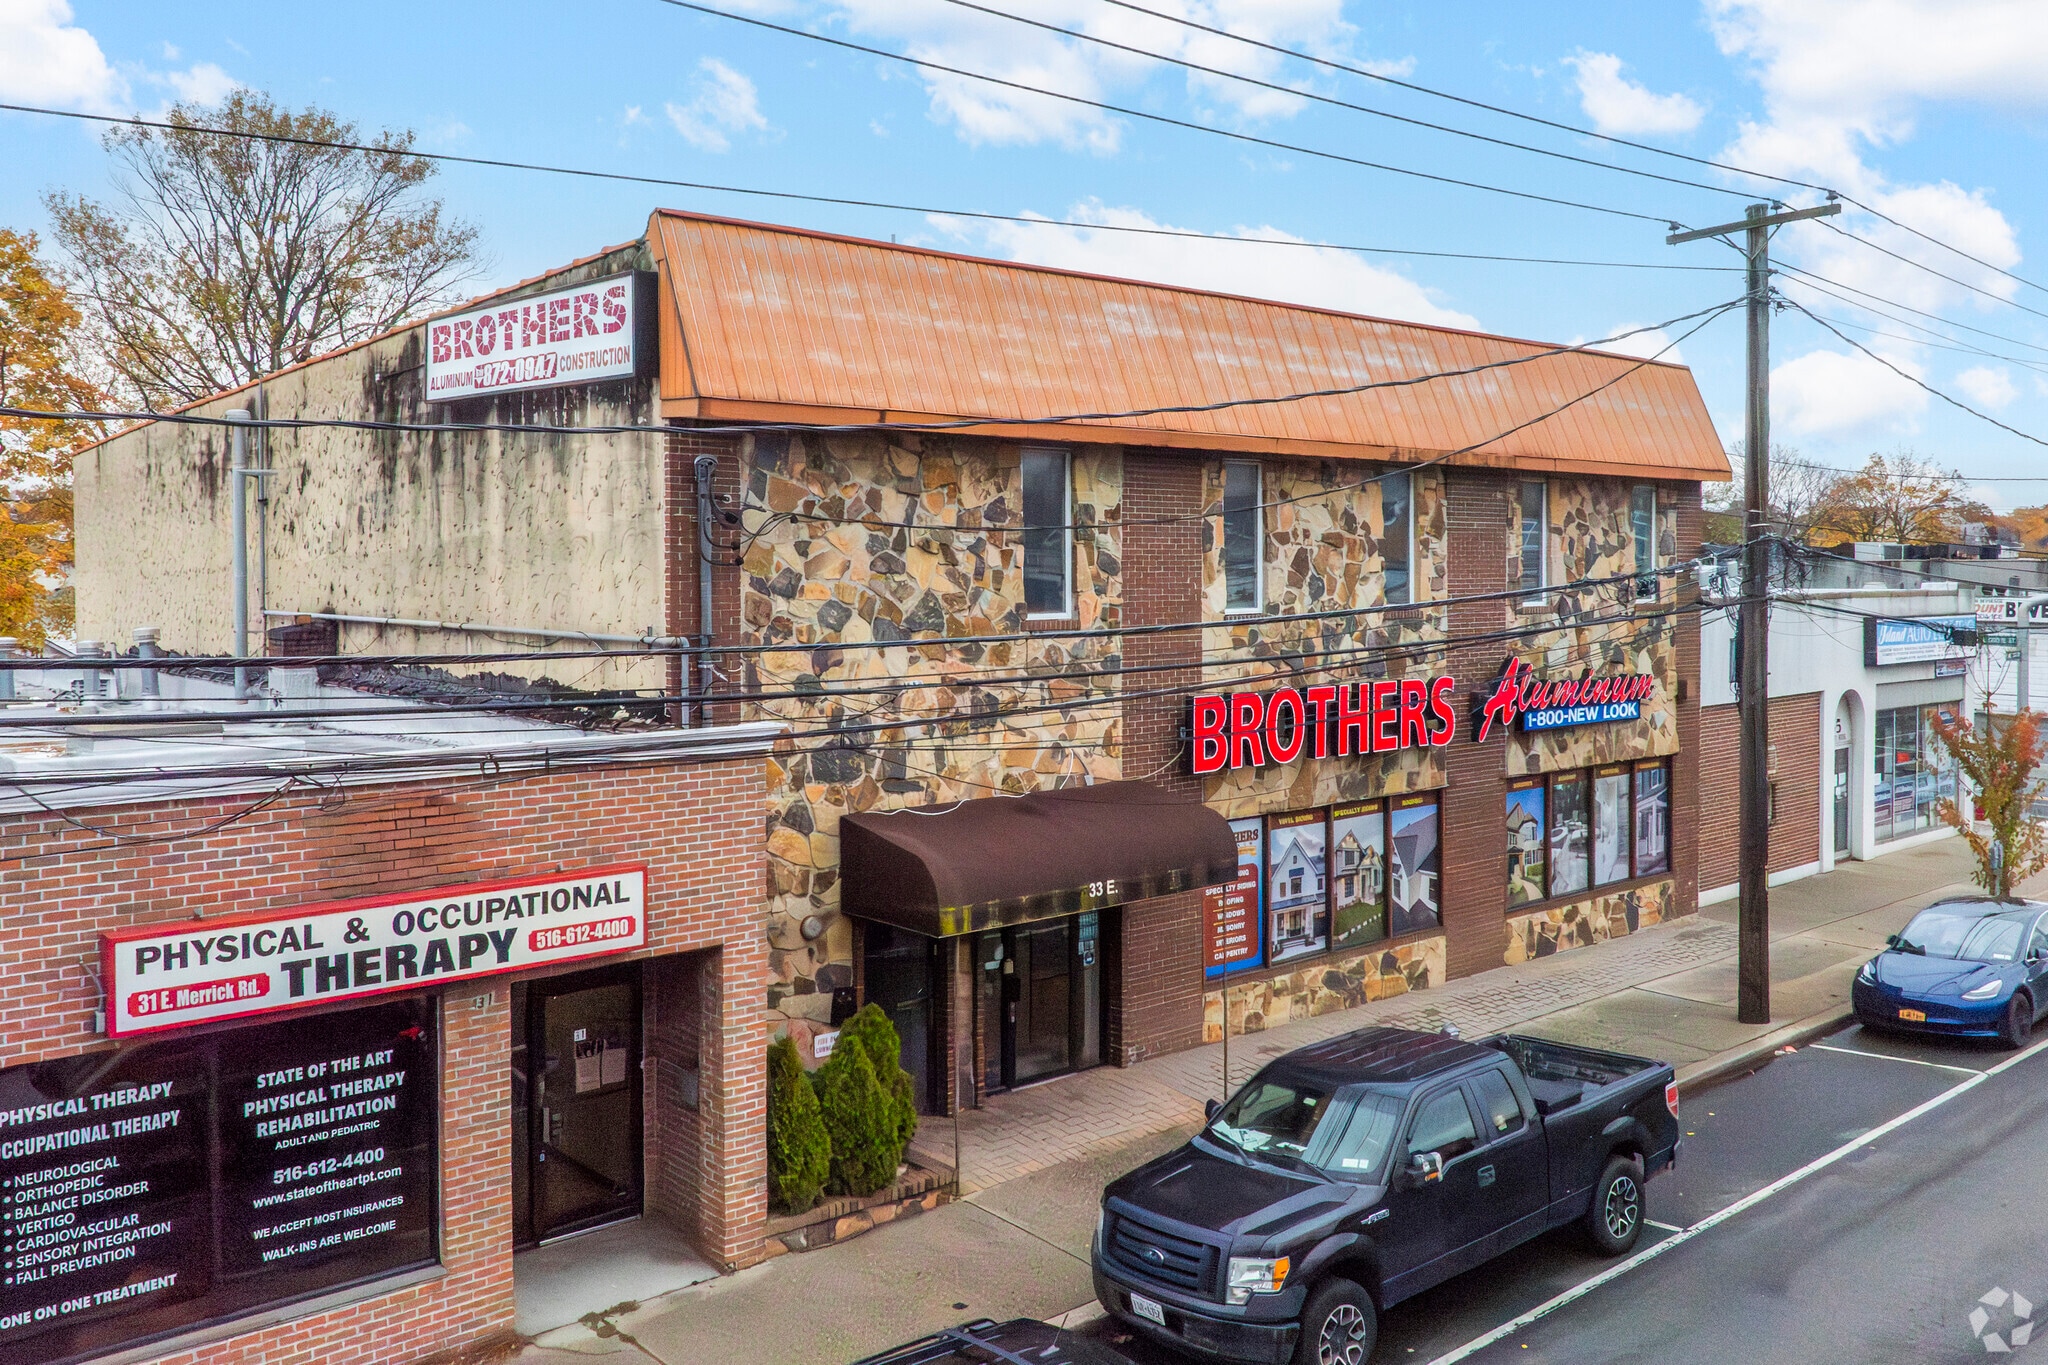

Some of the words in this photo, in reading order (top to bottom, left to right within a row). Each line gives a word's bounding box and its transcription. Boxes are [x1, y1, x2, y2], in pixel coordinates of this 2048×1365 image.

[433, 285, 627, 364] BROTHERS
[430, 371, 473, 391] ALUMINUM
[560, 345, 630, 371] CONSTRUCTION
[1478, 655, 1655, 743] Aluminum
[1527, 706, 1599, 728] 1-800-NEW
[1603, 702, 1638, 719] LOOK
[1193, 676, 1456, 774] BROTHERS
[1089, 881, 1103, 898] 33
[1106, 879, 1118, 895] E.
[136, 923, 324, 975] PHYSICAL
[343, 917, 370, 945] &
[392, 880, 630, 936] OCCUPATIONAL
[281, 927, 518, 998] THERAPY
[536, 918, 629, 949] 516-612-4400
[138, 993, 157, 1014] 31
[160, 990, 174, 1010] E.
[176, 982, 234, 1008] Merrick
[238, 978, 260, 998] Rd.
[256, 1067, 303, 1089] STATE
[307, 1062, 327, 1078] OF
[331, 1056, 360, 1074] THE
[363, 1050, 394, 1069] ART
[0, 1097, 87, 1128] PHYSICAL
[91, 1081, 173, 1111] THERAPY
[243, 1087, 327, 1118] PHYSICAL
[331, 1071, 406, 1099] THERAPY
[0, 1124, 110, 1160] CCUPATIONAL
[112, 1110, 181, 1137] THERAPY
[256, 1095, 396, 1138] REHABILITATION
[275, 1135, 307, 1150] ADULT
[308, 1130, 329, 1143] AND
[331, 1120, 380, 1138] PEDIATRIC
[14, 1156, 120, 1188] NEUROLOGICAL
[253, 1166, 402, 1209] www.stateoftheartpt.com
[273, 1148, 385, 1185] 516-612-4400
[15, 1175, 104, 1204] ORTHOPEDIC
[15, 1195, 78, 1220] BALANCE
[83, 1180, 149, 1205] DISORDER
[16, 1212, 75, 1236] VERTIGO
[16, 1213, 139, 1252] CARDIOVASCULAR
[253, 1228, 270, 1240] WE
[272, 1217, 312, 1236] ACCEPT
[314, 1210, 341, 1226] MOST
[343, 1195, 404, 1218] INSURANCES
[16, 1243, 79, 1269] SENSORY
[83, 1221, 171, 1253] INTEGRATION
[262, 1240, 317, 1262] WALK-INS
[319, 1233, 341, 1248] ARE
[343, 1219, 396, 1242] WELCOME
[16, 1265, 47, 1285] FALL
[51, 1245, 135, 1276] PREVENTION
[0, 1310, 31, 1329] ONE
[34, 1304, 57, 1321] ON
[60, 1296, 91, 1316] ONE
[94, 1273, 177, 1305] TREATMENT
